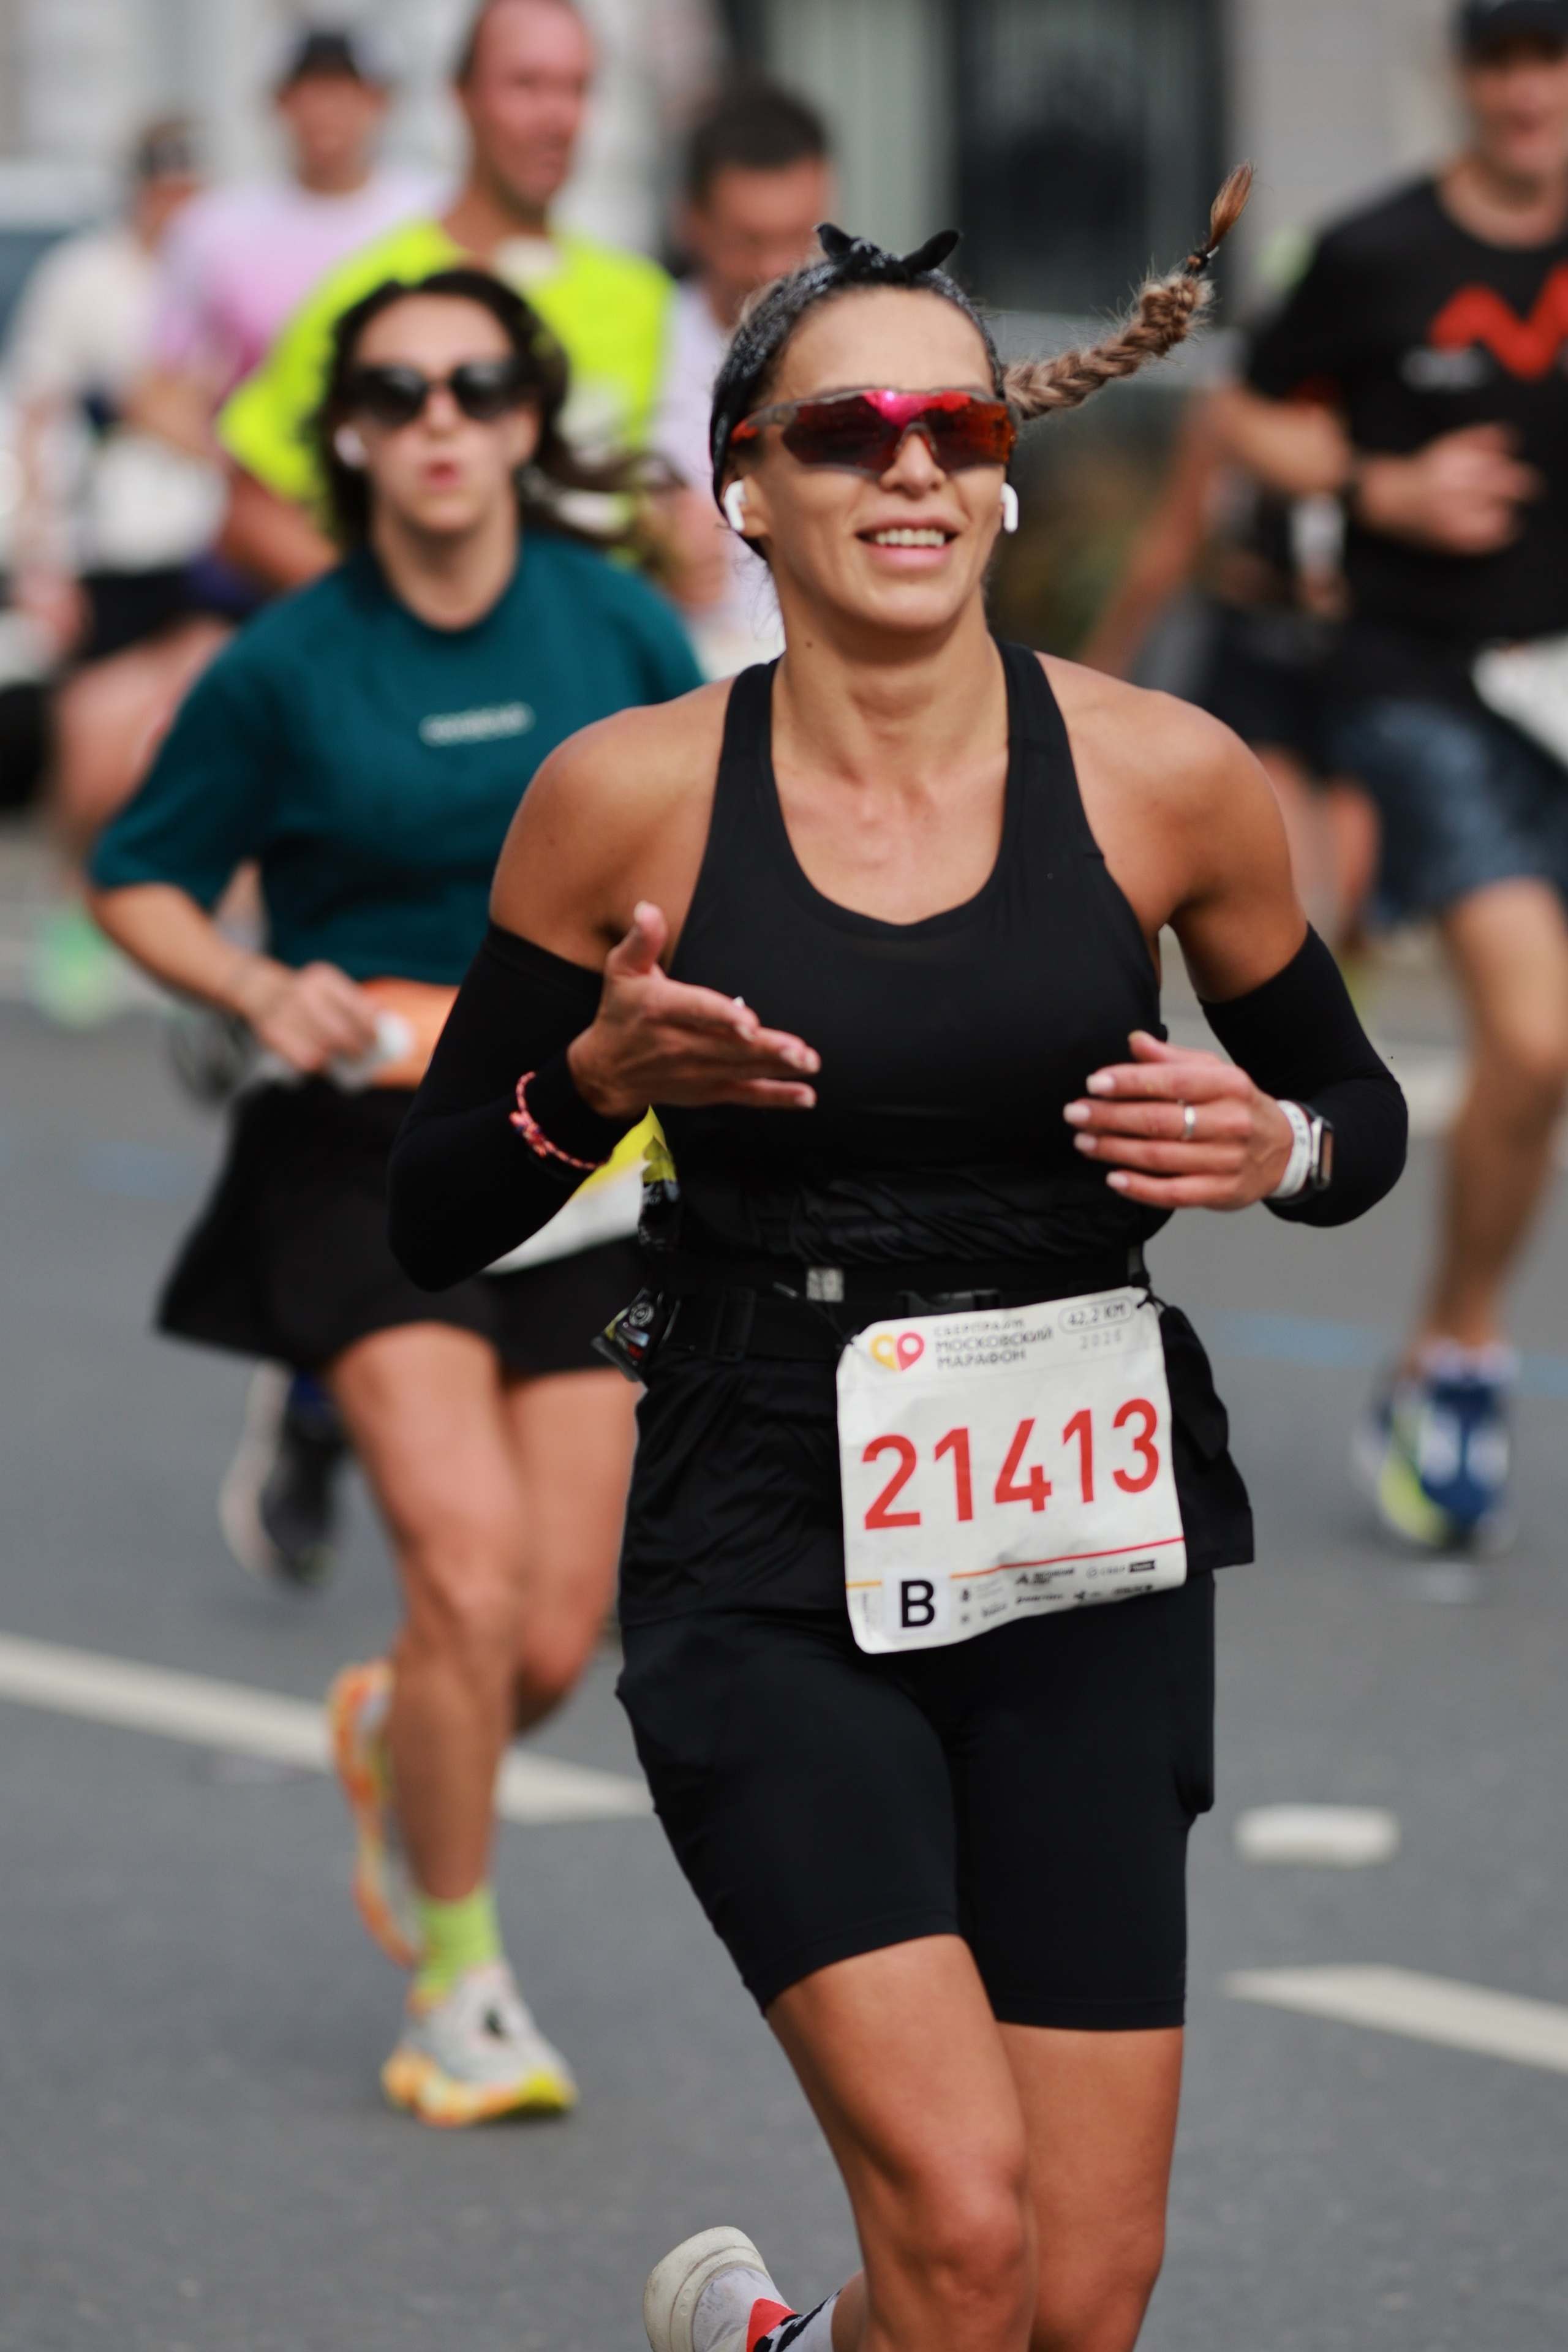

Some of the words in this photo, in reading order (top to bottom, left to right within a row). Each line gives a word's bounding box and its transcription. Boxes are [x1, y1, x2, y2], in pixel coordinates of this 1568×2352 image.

[936, 1326, 1054, 1352] МОСКОВСКИЙ
[938, 1348, 1026, 1369] МАРАФОН
[862, 1398, 1159, 1530] 21413
[900, 1580, 935, 1628] B
